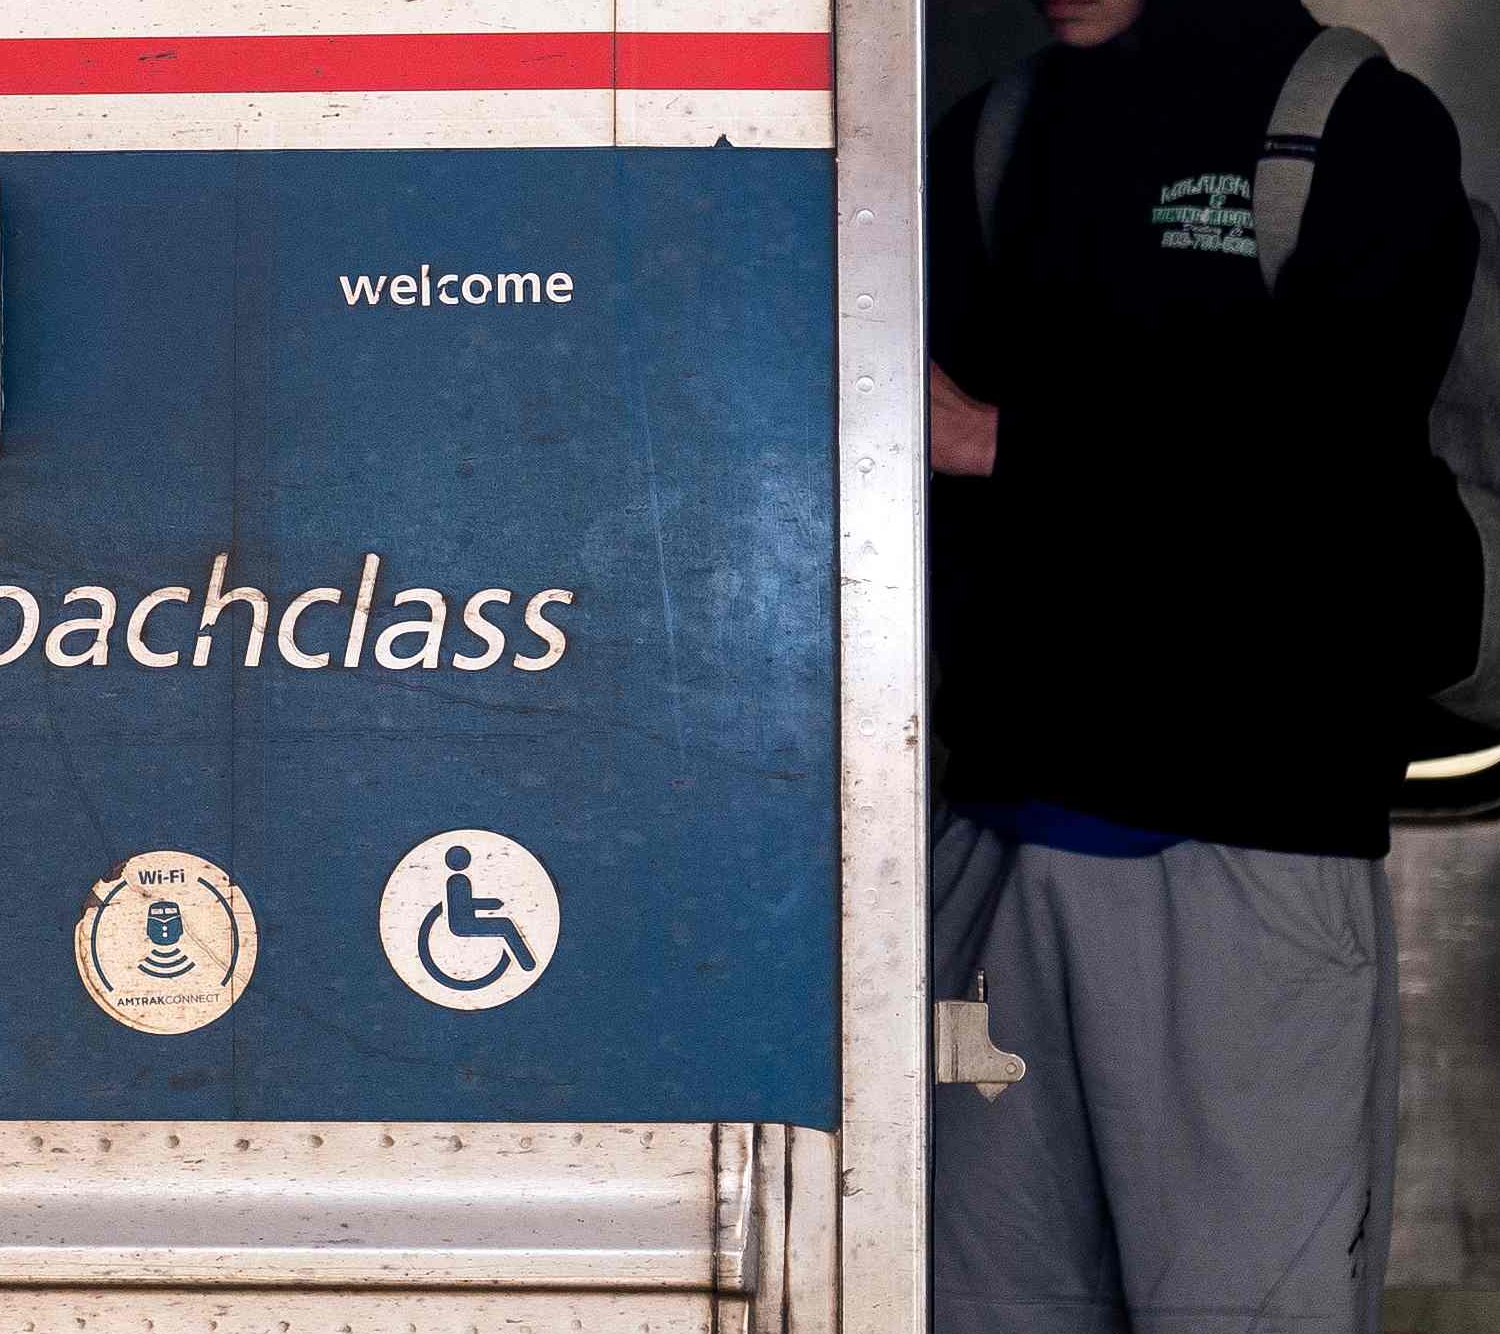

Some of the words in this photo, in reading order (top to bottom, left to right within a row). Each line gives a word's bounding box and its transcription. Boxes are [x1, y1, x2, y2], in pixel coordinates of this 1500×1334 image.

[339, 264, 574, 307] welcome
[138, 869, 185, 884] Wi-Fi
[117, 993, 221, 1007] AMTRAKCONNECT
